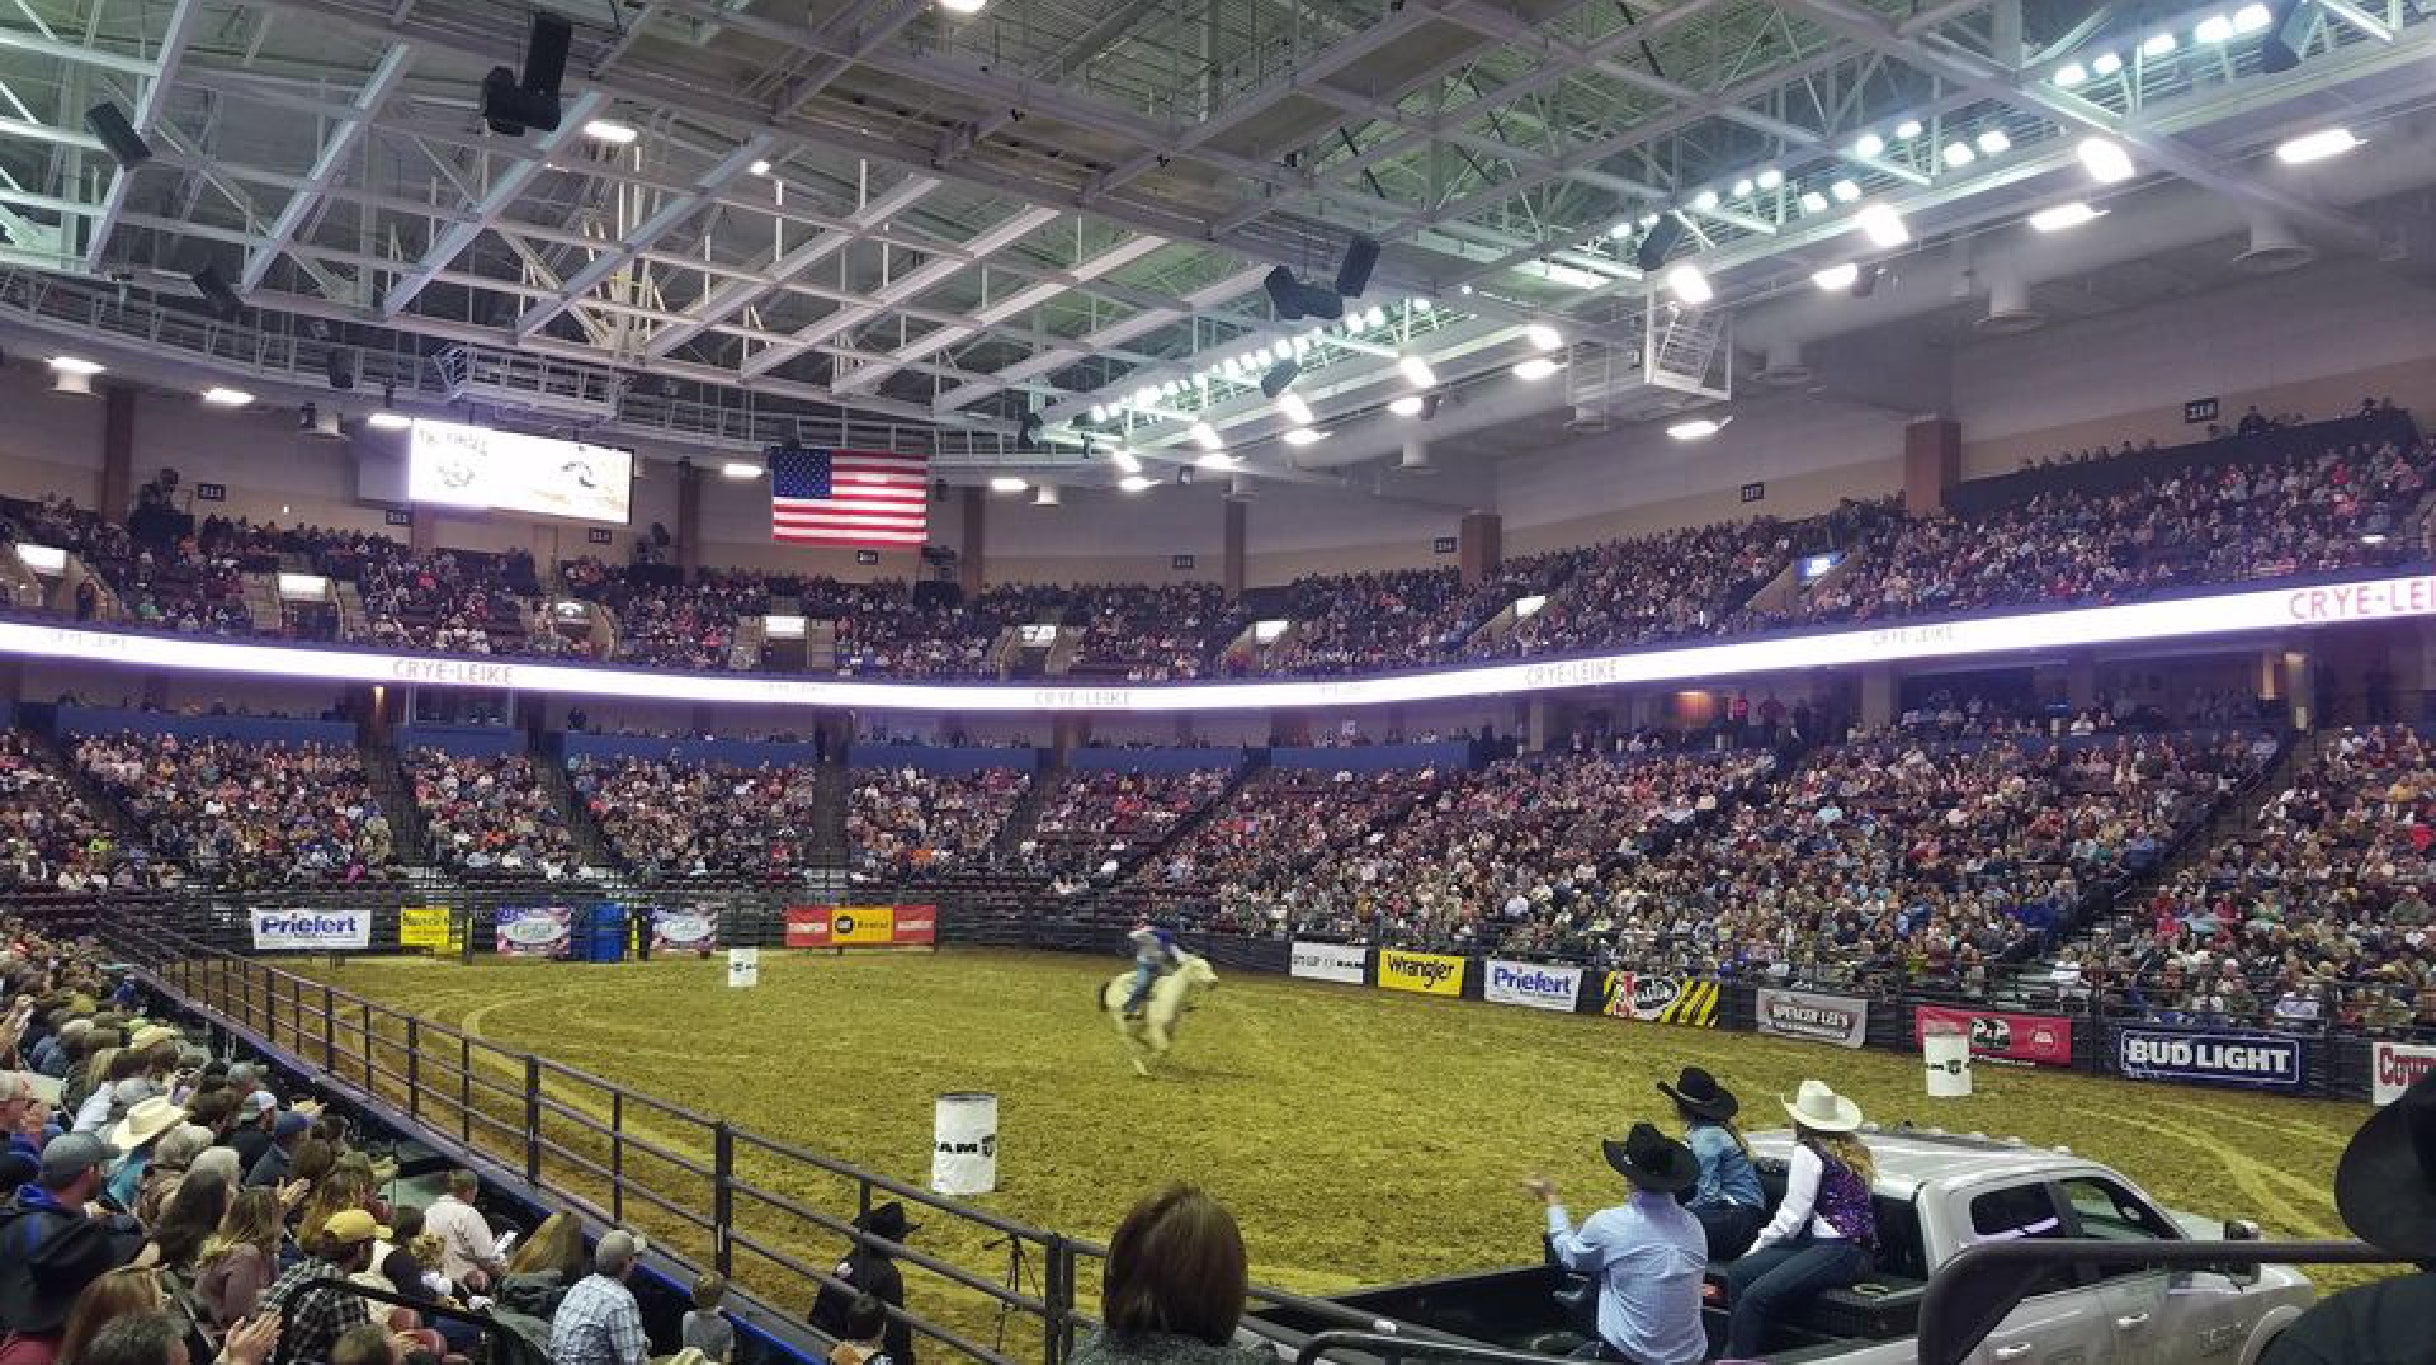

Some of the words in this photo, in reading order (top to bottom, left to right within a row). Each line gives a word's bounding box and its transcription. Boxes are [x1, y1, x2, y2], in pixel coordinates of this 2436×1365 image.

[391, 658, 514, 684] CRYE-LEIKE
[260, 912, 355, 934] Priefert
[1387, 954, 1455, 989] Wrangler
[1494, 966, 1572, 994] Priefert
[2128, 1039, 2193, 1065] BUD
[2195, 1044, 2291, 1072] LIGHT
[934, 1141, 978, 1153] AM
